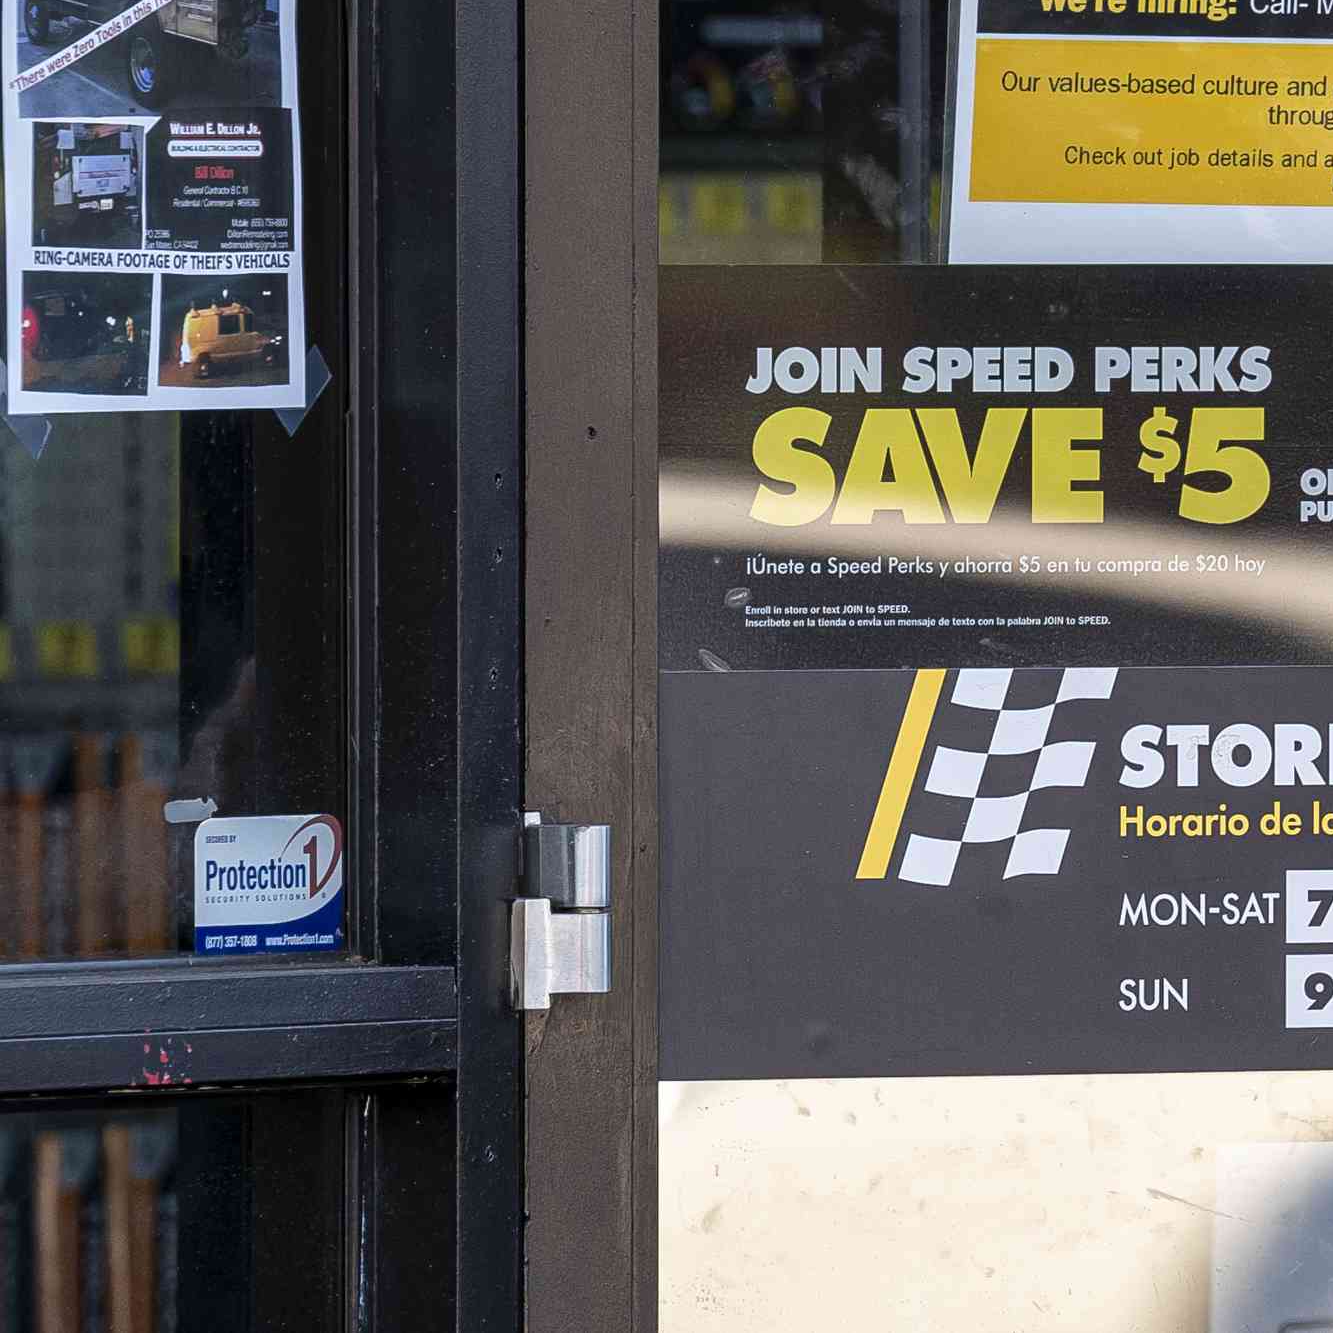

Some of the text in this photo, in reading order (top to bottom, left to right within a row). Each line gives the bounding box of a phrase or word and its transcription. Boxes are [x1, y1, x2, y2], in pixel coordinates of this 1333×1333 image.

[48, 51, 72, 72] were
[73, 38, 95, 60] Zero
[94, 23, 122, 45] Tools
[123, 14, 132, 31] in
[134, 3, 152, 22] this
[1001, 70, 1041, 93] Our
[1047, 71, 1196, 95] values-based
[1202, 73, 1279, 97] culture
[1286, 74, 1327, 97] and
[1063, 145, 1126, 166] Check
[1132, 148, 1163, 166] out
[1168, 147, 1200, 170] job
[1207, 148, 1273, 167] details
[1280, 149, 1318, 169] and
[34, 251, 113, 268] RING-CAMERA
[117, 253, 170, 269] FOOTAGE
[173, 254, 189, 268] OF
[236, 253, 290, 269] VEHICALS
[745, 346, 1271, 394] JOIN SPEED PERKS
[749, 406, 1271, 527] SAVE $5
[810, 561, 821, 575] a
[827, 556, 882, 579] Speed
[888, 556, 933, 575] Perks
[939, 560, 948, 579] y
[954, 555, 1013, 575] ahorra
[1019, 554, 1041, 575] $5
[1047, 560, 1069, 574] en
[1074, 558, 1091, 574] tu
[1097, 559, 1161, 579] compra
[1167, 554, 1189, 573] de
[1195, 553, 1228, 575] $20
[1234, 554, 1265, 578] hoy
[1118, 803, 1250, 838] Horario
[1259, 802, 1303, 836] de
[205, 858, 306, 891] Protection
[205, 893, 306, 904] SECURITY SOLUTIONS
[1118, 891, 1281, 928] MON-SAT
[205, 935, 223, 949] (877)
[265, 933, 334, 946] www.Protection1.com
[1118, 978, 1189, 1012] SUN
